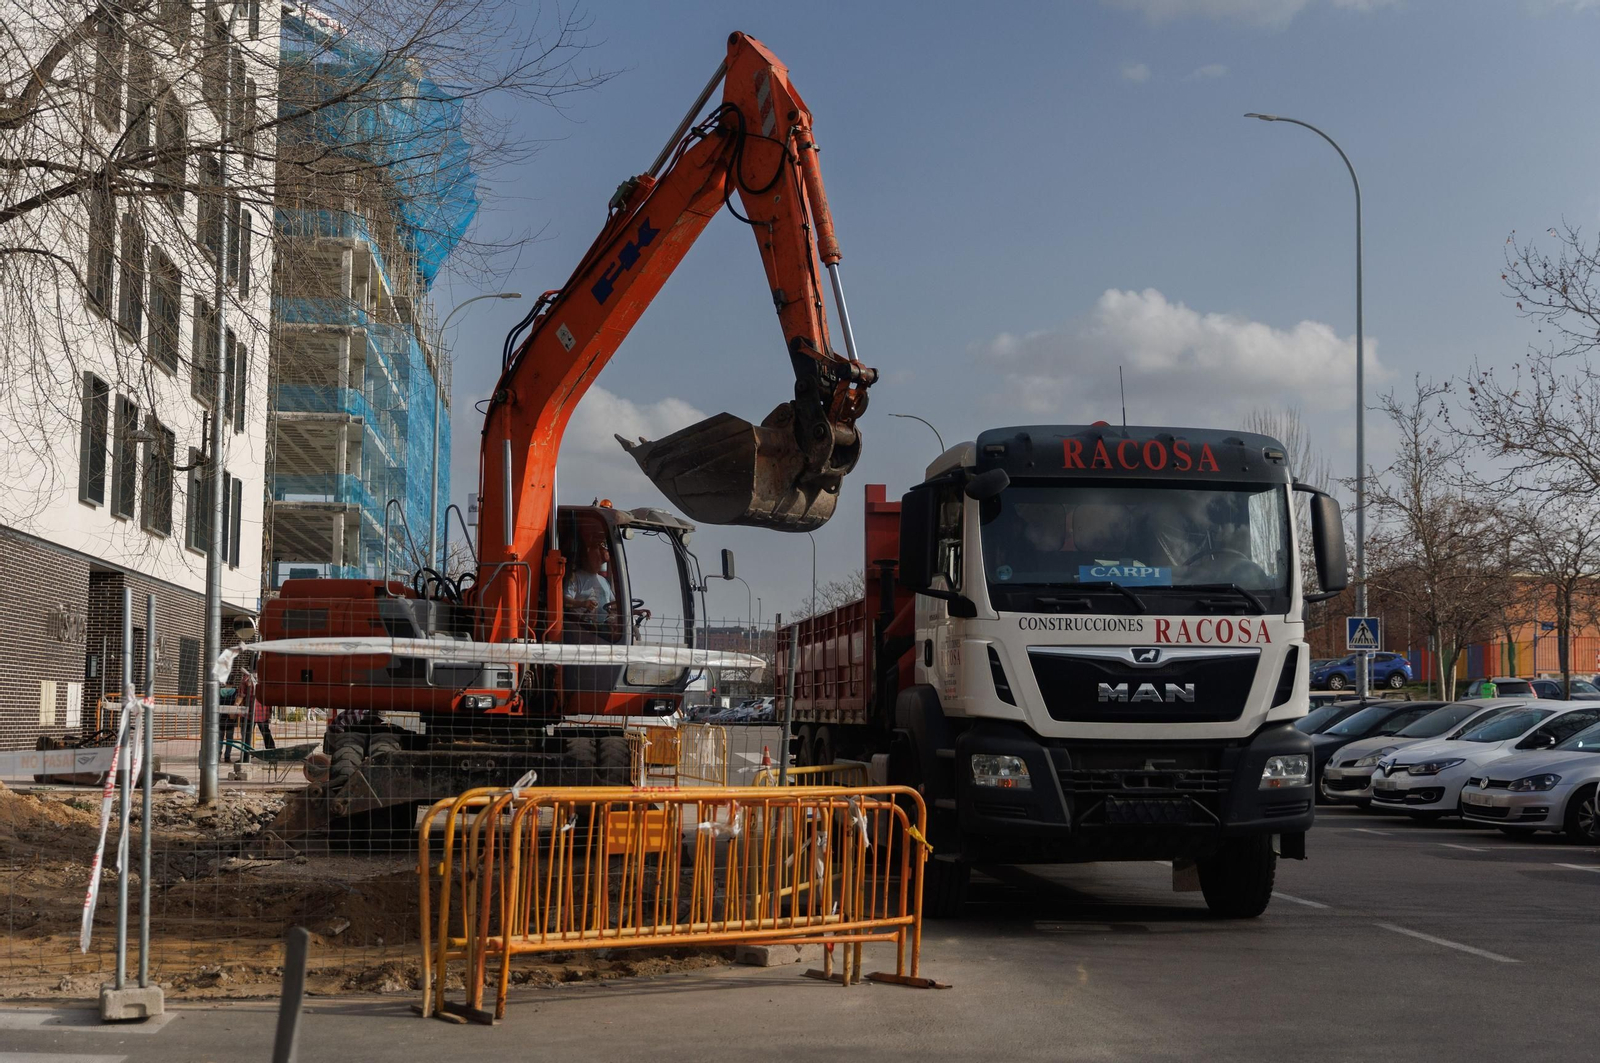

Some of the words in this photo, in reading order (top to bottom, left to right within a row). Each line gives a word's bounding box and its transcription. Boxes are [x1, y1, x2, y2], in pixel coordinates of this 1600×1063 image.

[1062, 438, 1221, 473] RACOSA
[1090, 566, 1160, 579] CARPI
[1018, 616, 1144, 632] CONSTRUCCIONES
[1154, 618, 1272, 644] RACOSA
[1098, 682, 1195, 703] MAN
[21, 754, 39, 769] NO
[103, 781, 115, 799] NO
